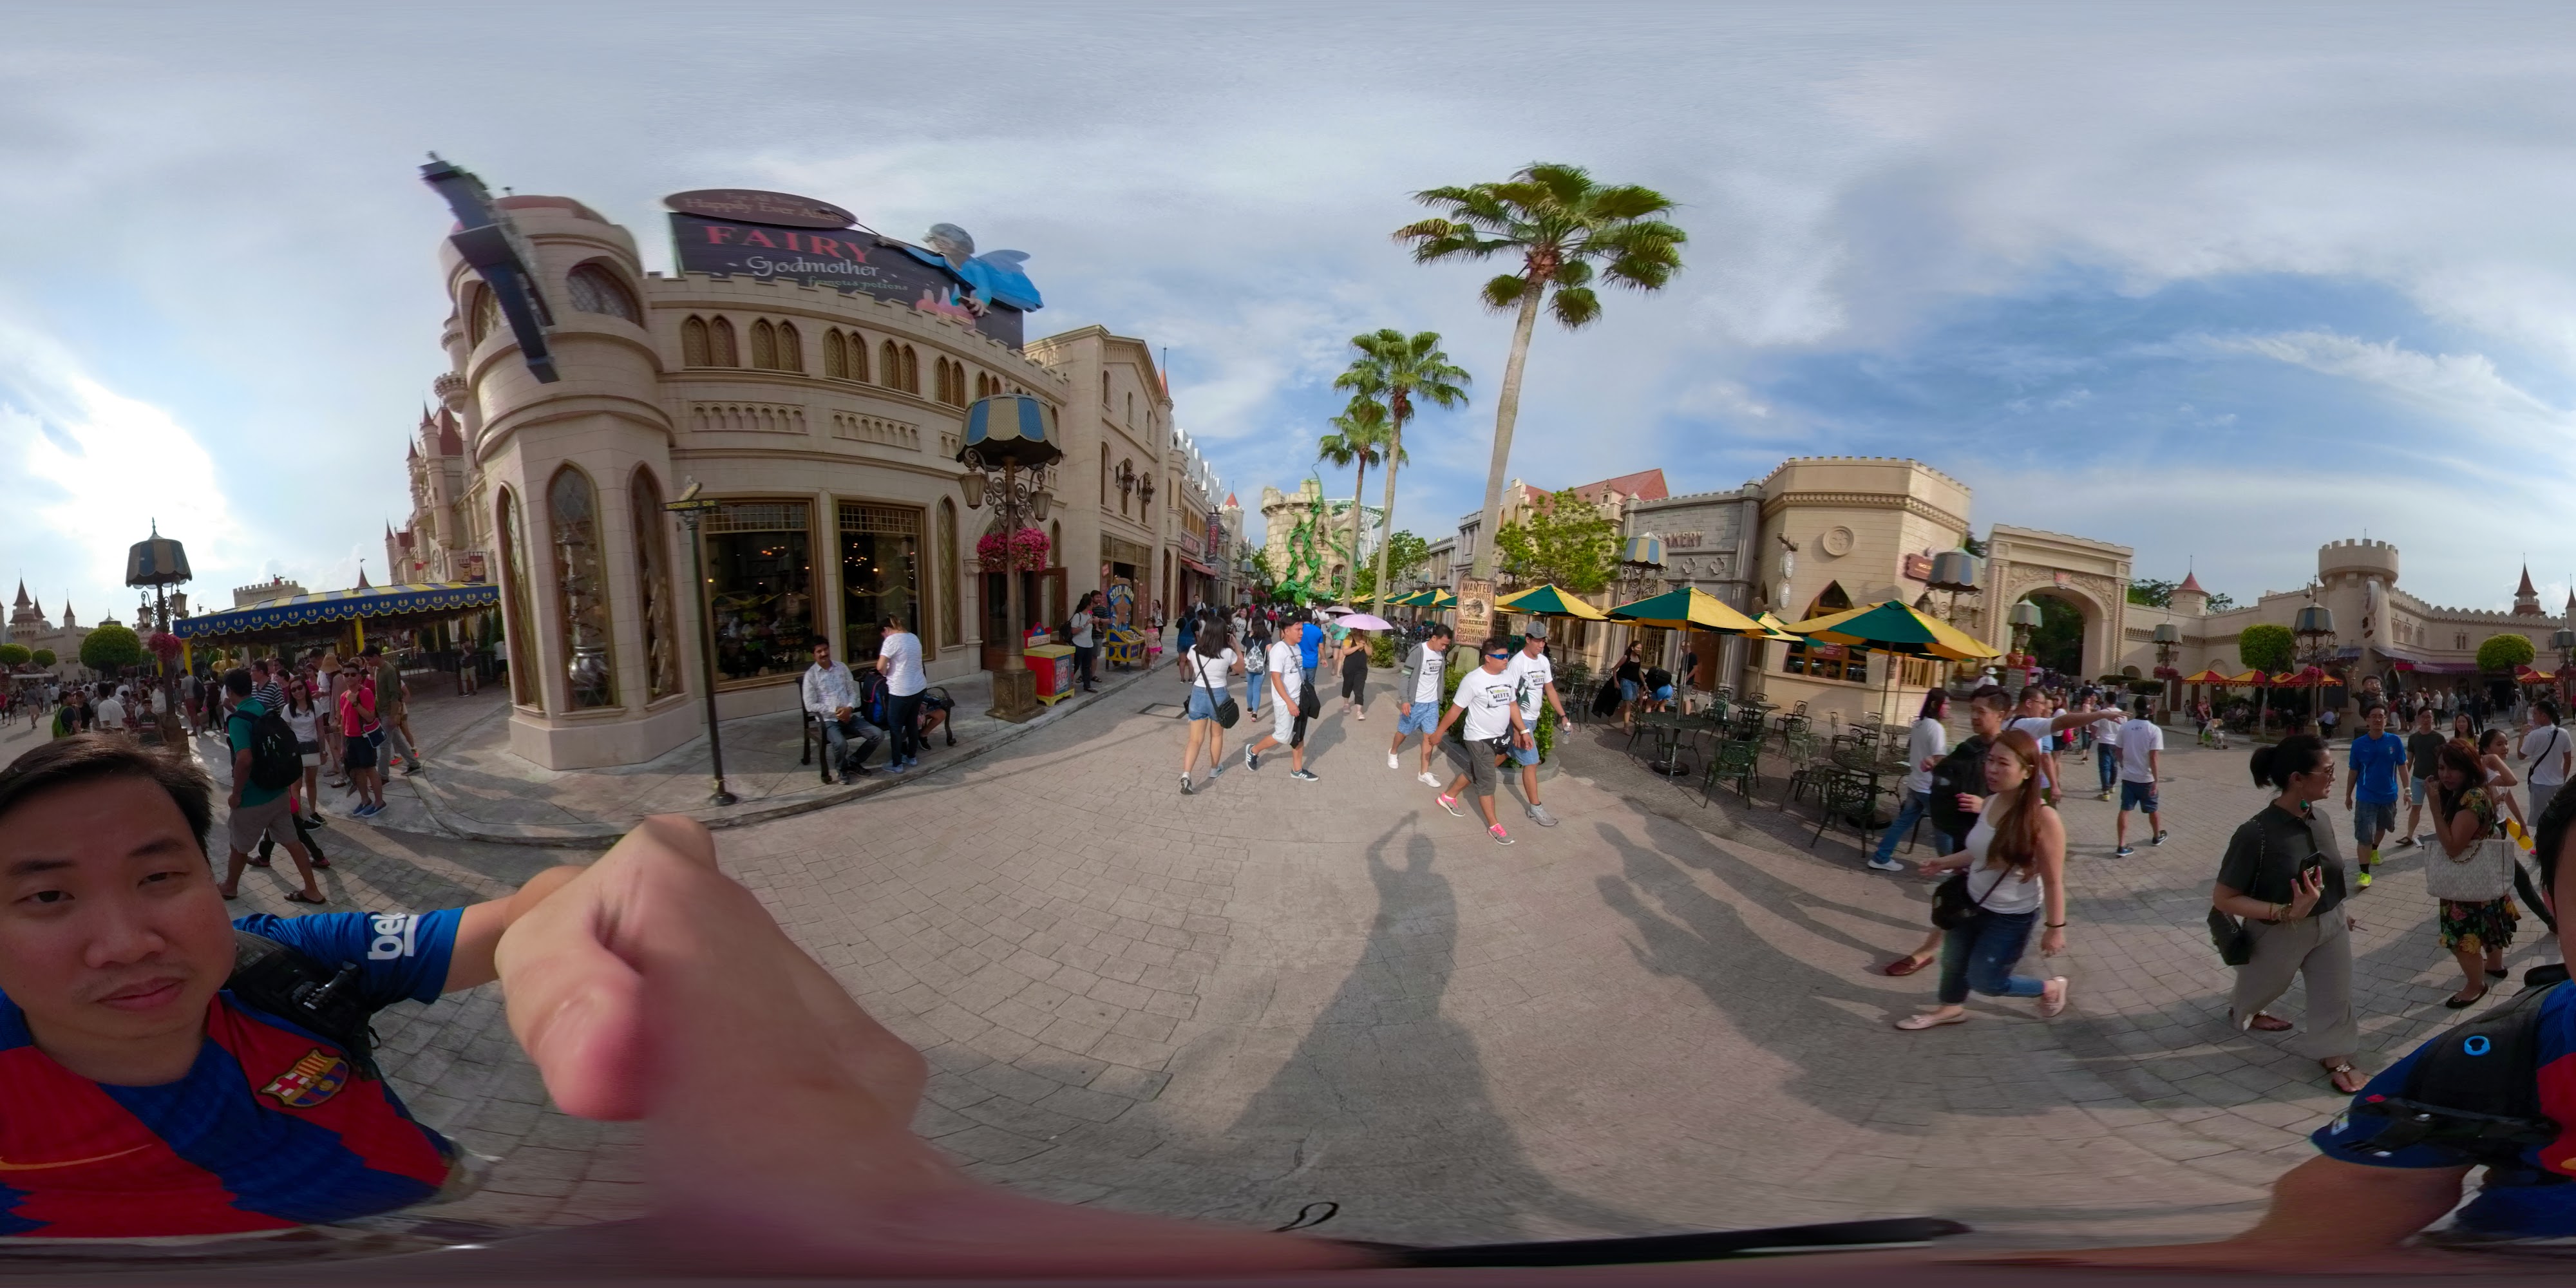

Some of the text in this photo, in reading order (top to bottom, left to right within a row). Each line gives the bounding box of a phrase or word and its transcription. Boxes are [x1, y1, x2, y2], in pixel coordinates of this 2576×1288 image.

[683, 198, 753, 214] Happily
[758, 202, 797, 214] Ever
[704, 225, 874, 263] FAIRY
[746, 255, 880, 277] Godmother
[666, 501, 699, 510] ROMEO
[1110, 585, 1122, 602] STAR
[1463, 582, 1492, 593] WANTED
[1457, 627, 1484, 636] CHARMING
